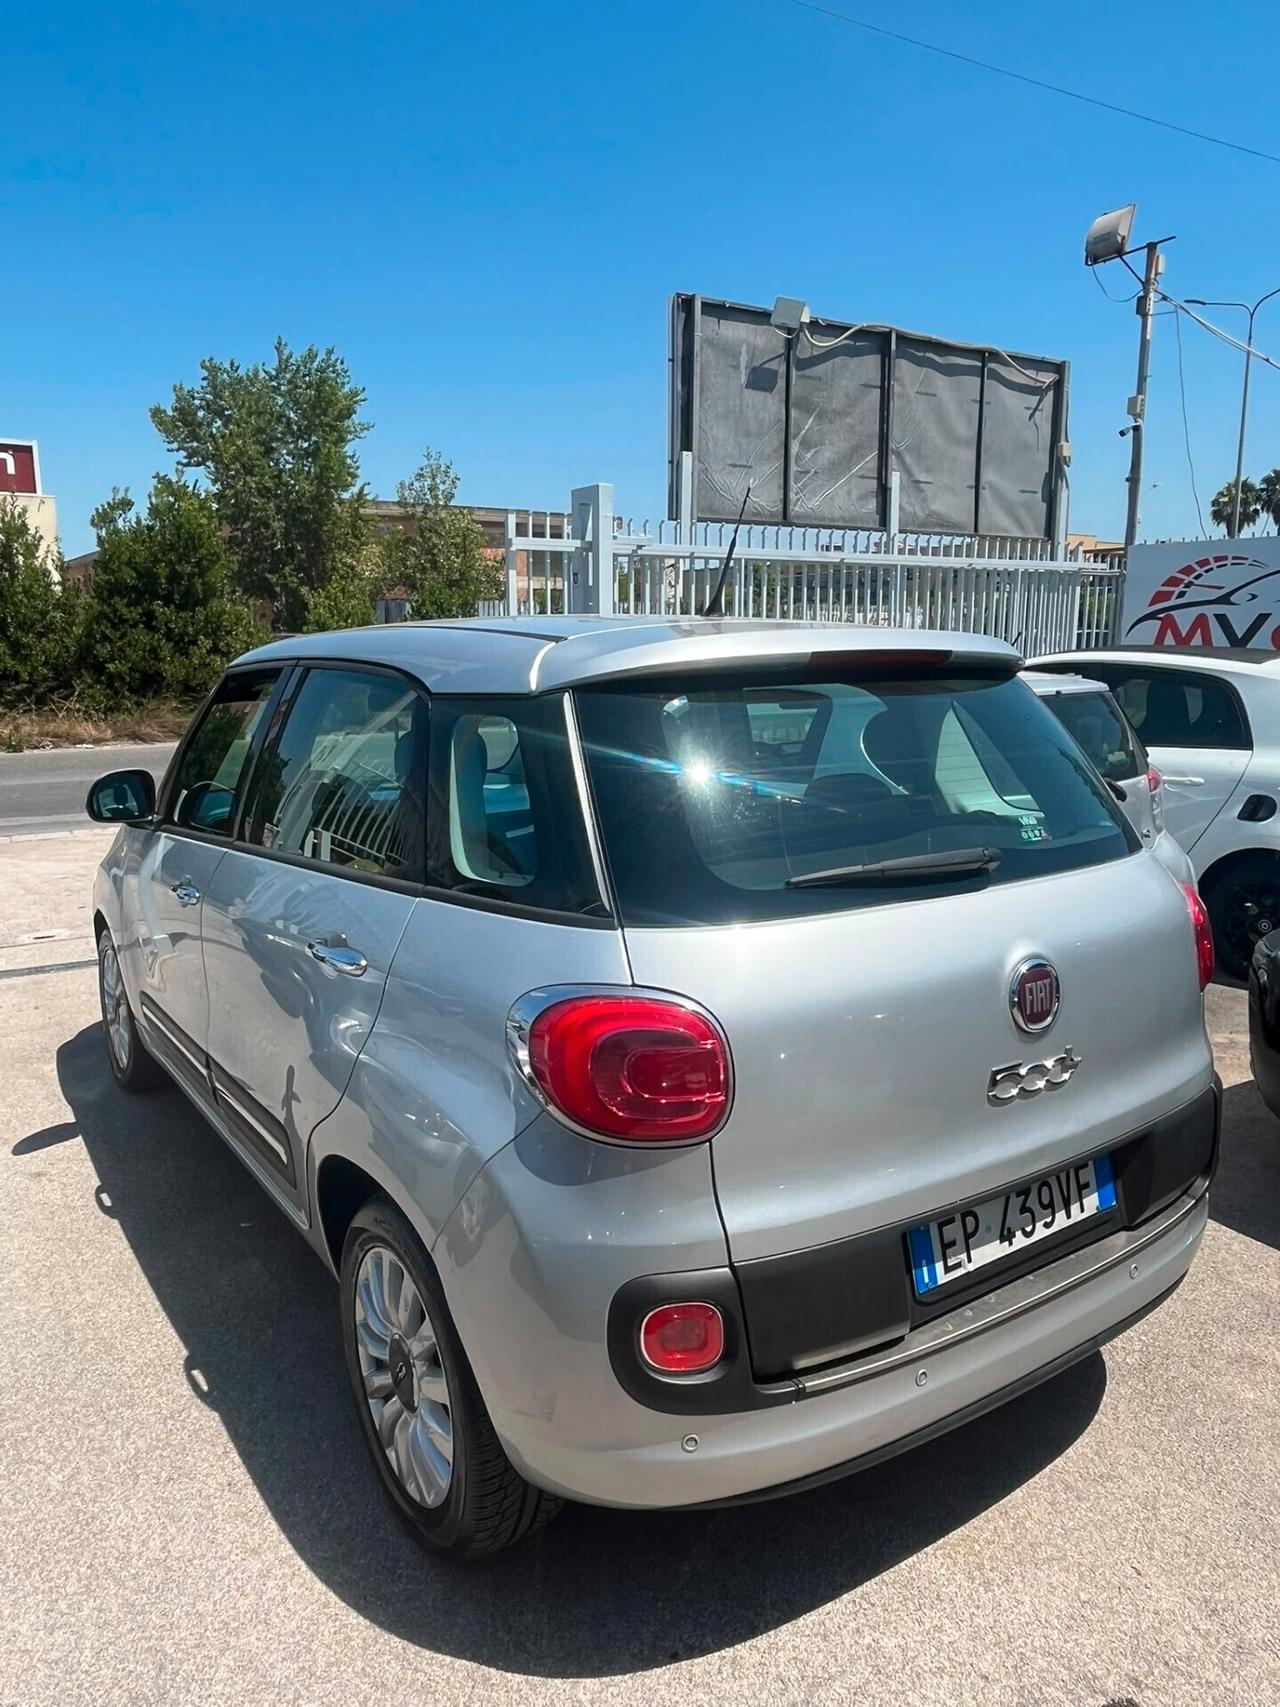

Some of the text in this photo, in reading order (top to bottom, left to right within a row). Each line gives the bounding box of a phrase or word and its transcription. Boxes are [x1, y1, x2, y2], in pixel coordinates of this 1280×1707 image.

[1025, 978, 1052, 1016] FIAT
[936, 1162, 1091, 1276] EP 439VF
